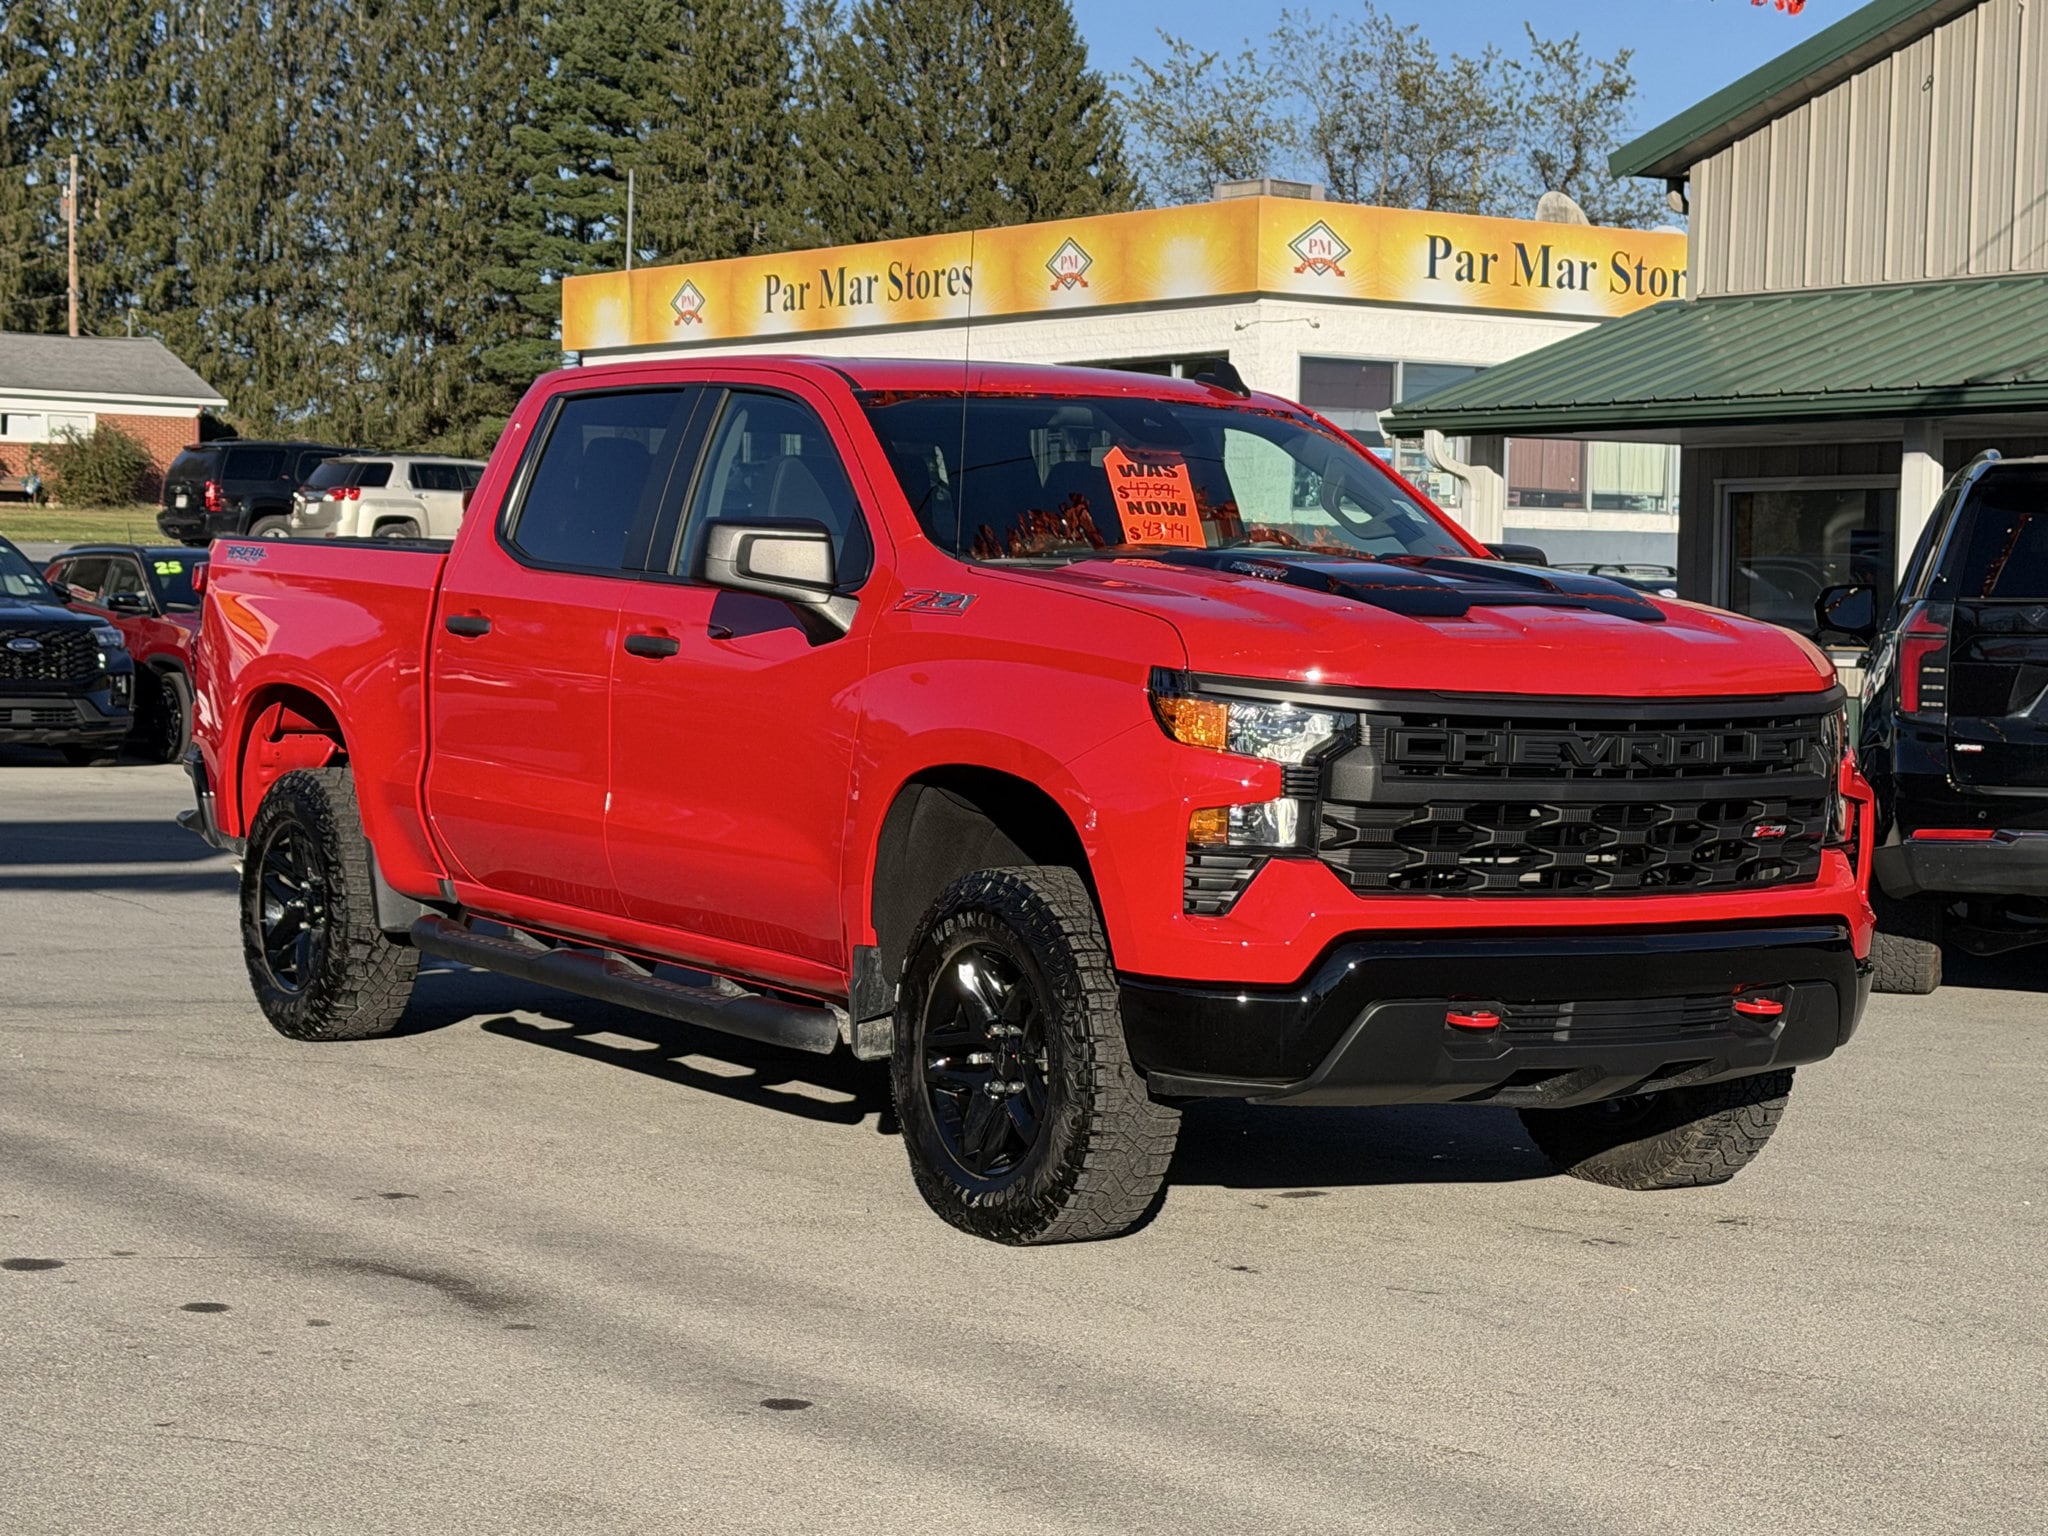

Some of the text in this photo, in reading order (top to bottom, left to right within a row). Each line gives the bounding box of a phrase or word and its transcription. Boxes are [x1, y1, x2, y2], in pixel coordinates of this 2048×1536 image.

[1308, 238, 1332, 256] PM
[1060, 255, 1078, 270] PM
[1424, 234, 1688, 298] Par Mar Stor
[764, 261, 973, 313] Par Mar Stores
[681, 294, 695, 309] PM
[1116, 464, 1178, 478] WAS
[1126, 501, 1187, 517] NOW
[225, 544, 267, 559] TRAIL
[153, 561, 183, 575] 25
